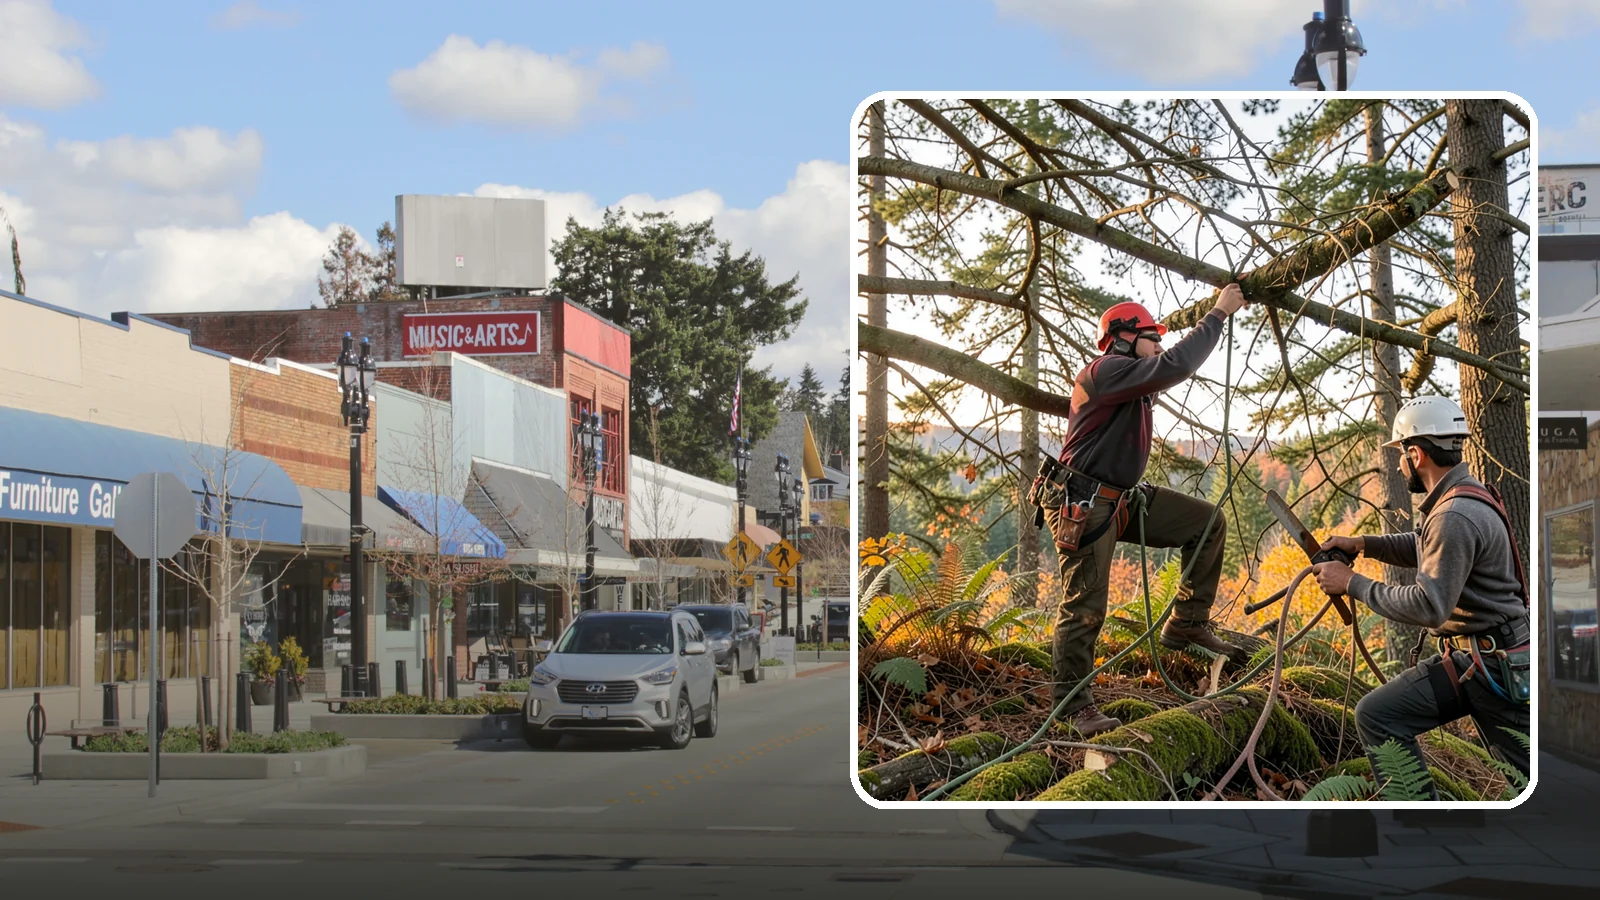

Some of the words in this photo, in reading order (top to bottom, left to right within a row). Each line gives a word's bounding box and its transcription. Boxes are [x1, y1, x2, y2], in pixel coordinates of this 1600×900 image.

[0, 471, 79, 515] Furniture
[89, 482, 122, 519] Gal
[454, 562, 480, 574] SUSHI
